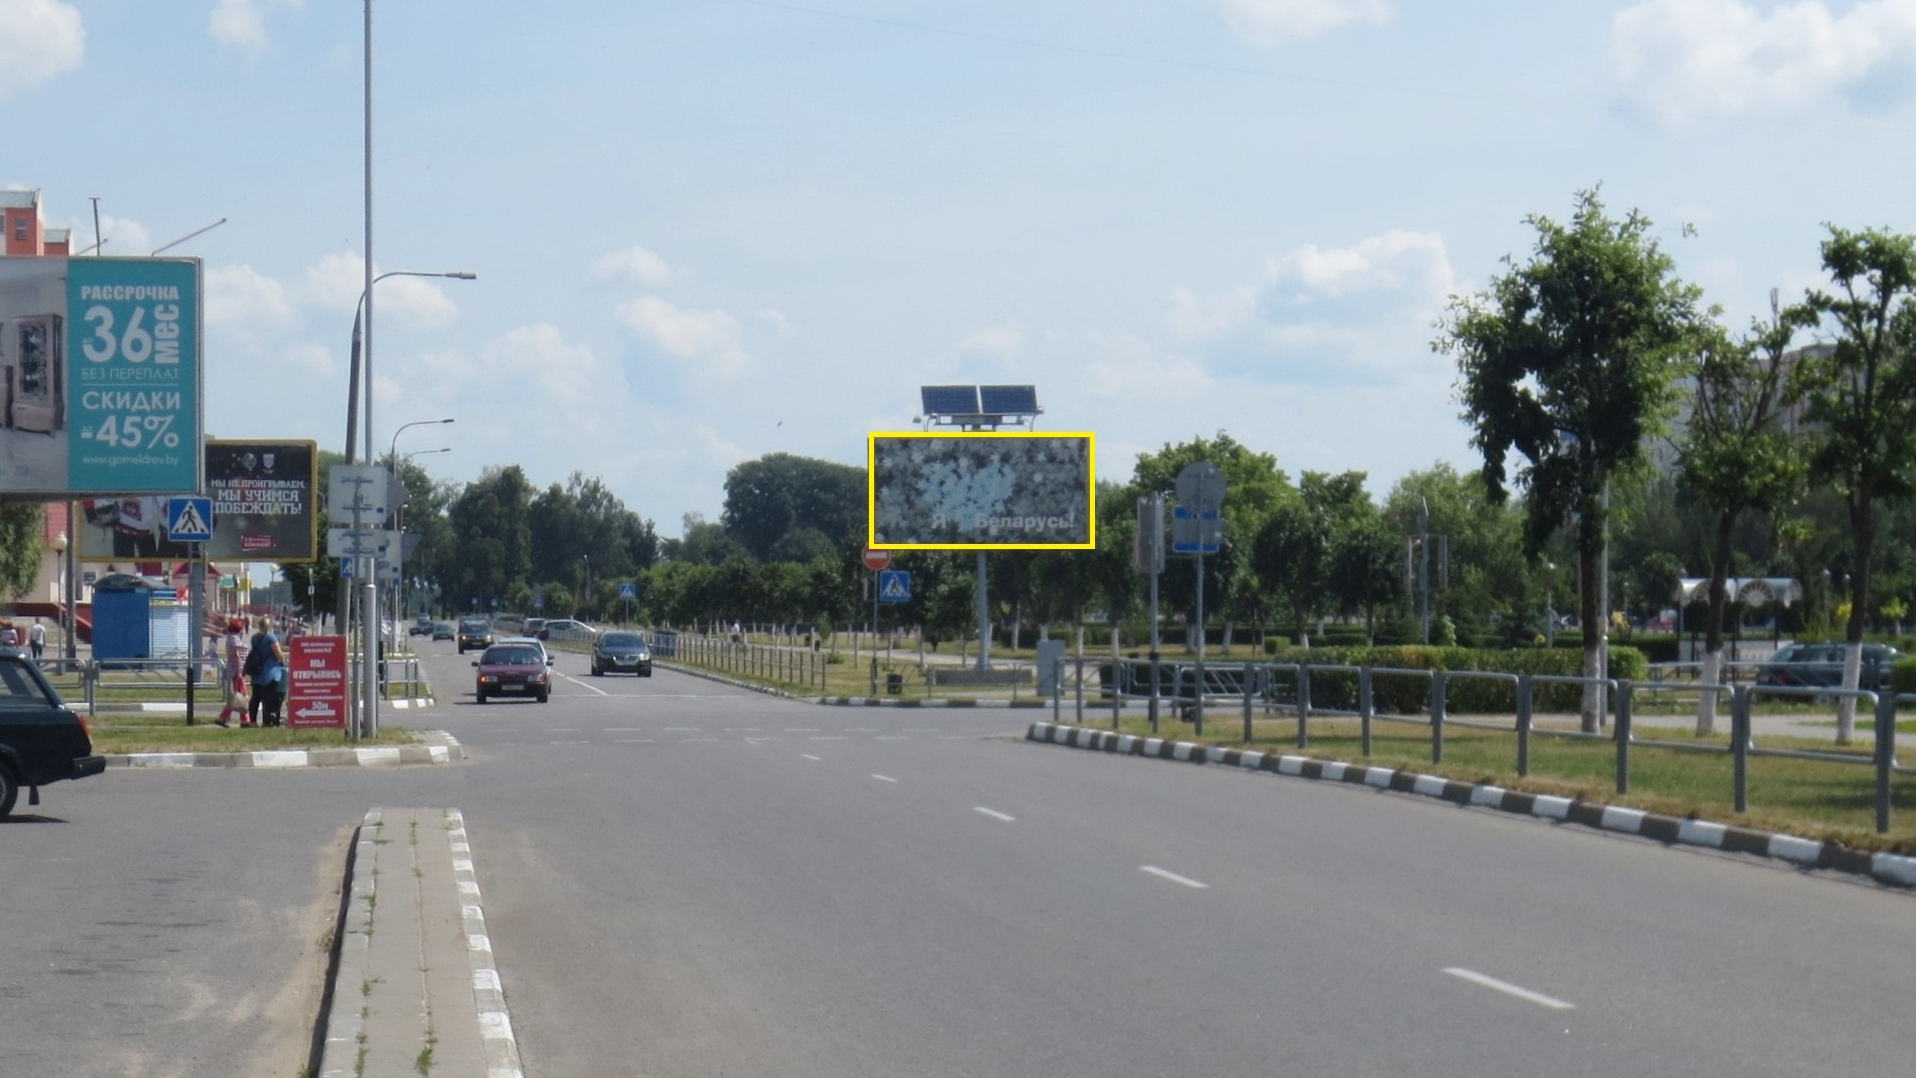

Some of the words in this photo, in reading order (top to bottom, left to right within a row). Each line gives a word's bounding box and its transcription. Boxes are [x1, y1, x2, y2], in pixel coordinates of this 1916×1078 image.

[81, 285, 179, 301] РАССРОЧКА
[82, 304, 152, 363] 36
[81, 367, 106, 380] БЕЗ
[109, 367, 179, 380] ПЕРЕПЛАТ
[82, 391, 180, 412] СКИДКИ
[211, 479, 226, 488] МЫ
[228, 480, 240, 488] НЕ
[218, 489, 240, 501] МЫ
[245, 490, 299, 502] УЧИМСЯ
[214, 502, 302, 515] ПОБЕЖДАТЬ!
[931, 512, 946, 529] Я
[974, 507, 1075, 532] Беларусь!
